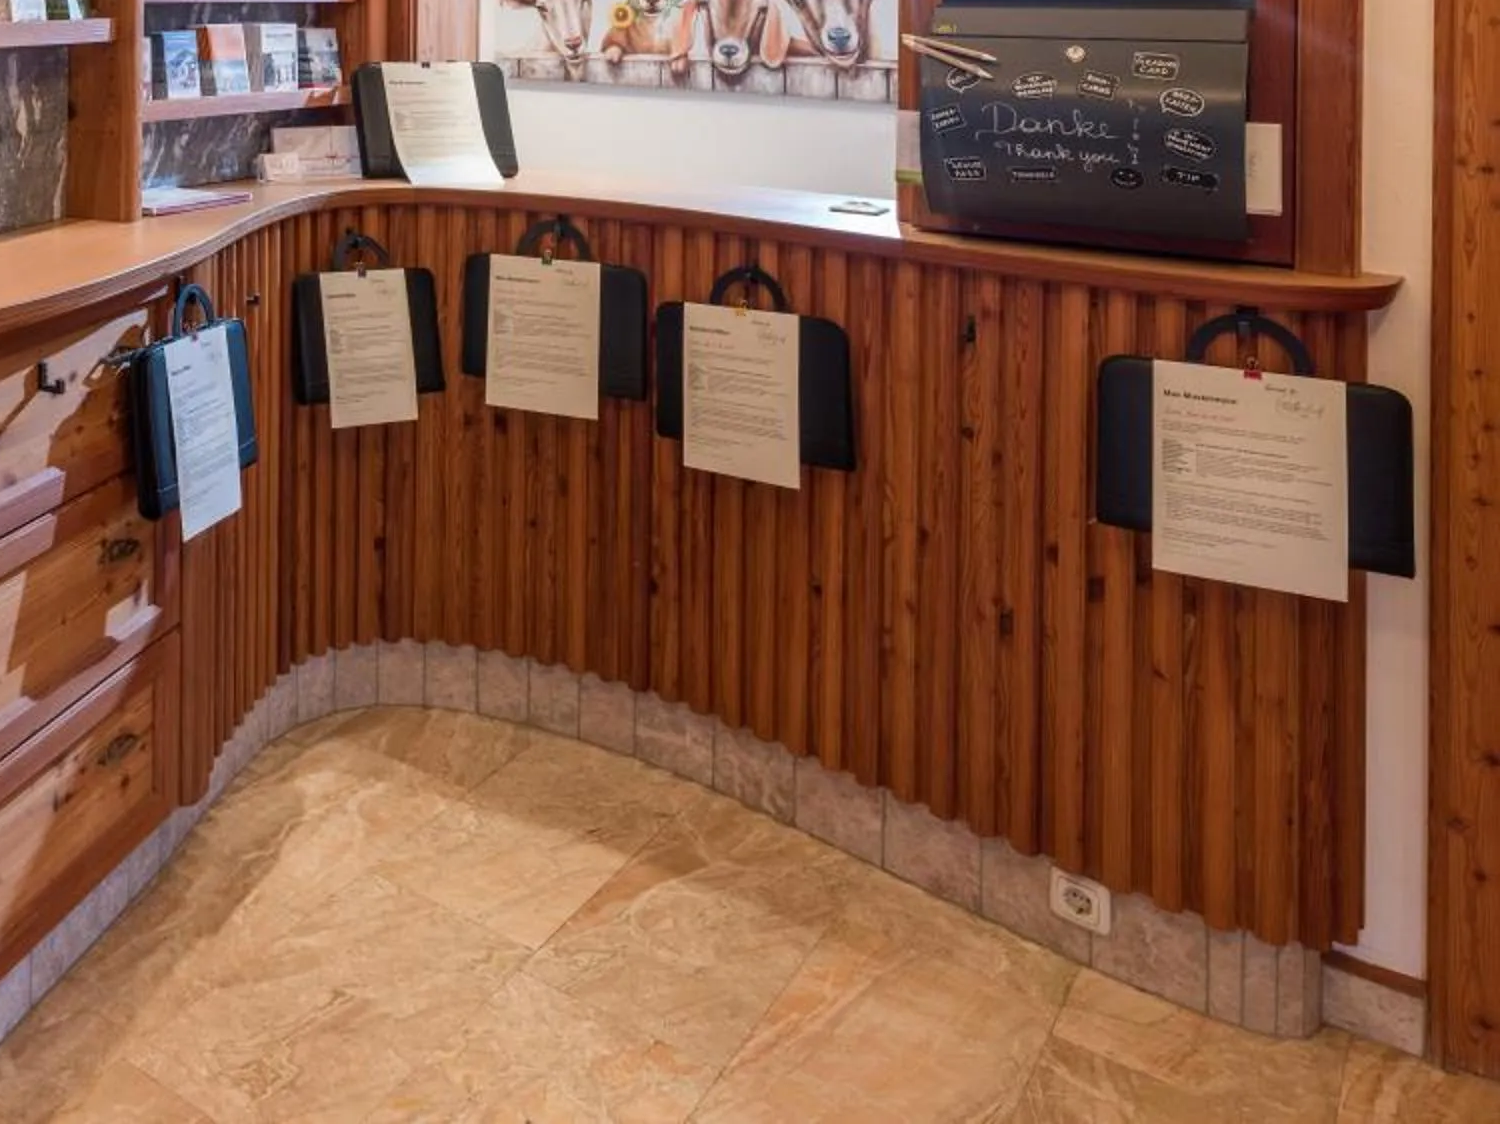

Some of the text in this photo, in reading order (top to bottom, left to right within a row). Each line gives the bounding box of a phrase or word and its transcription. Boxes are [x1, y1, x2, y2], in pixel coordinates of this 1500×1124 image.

[975, 101, 1121, 141] Danke
[994, 139, 1075, 161] Thank
[1079, 150, 1121, 173] you
